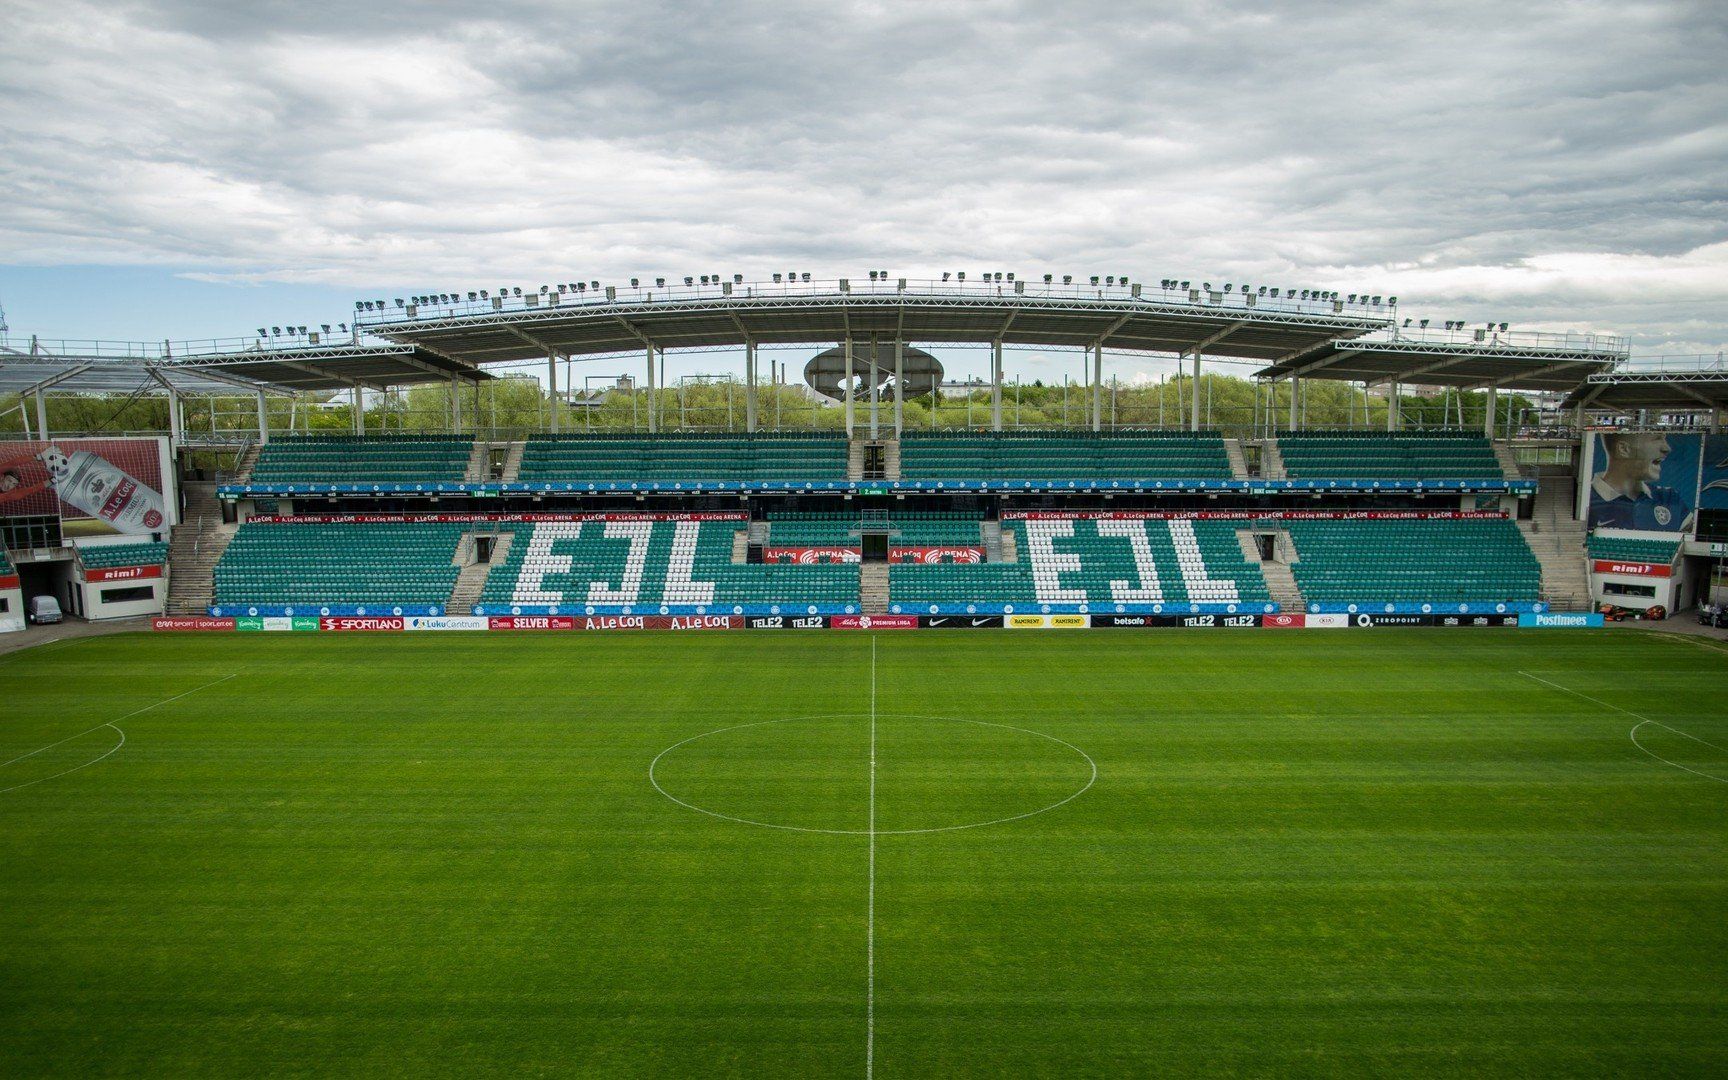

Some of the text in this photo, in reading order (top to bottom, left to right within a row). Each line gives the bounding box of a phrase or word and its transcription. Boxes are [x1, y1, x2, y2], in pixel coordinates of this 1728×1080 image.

[340, 619, 402, 629] SPORTLAND
[514, 618, 548, 628] SELVER
[752, 617, 783, 628] TELE2
[792, 617, 823, 628] TELE2
[1184, 615, 1214, 626] TELE2
[1224, 615, 1254, 626] TELE2
[1536, 614, 1586, 626] Postimees
